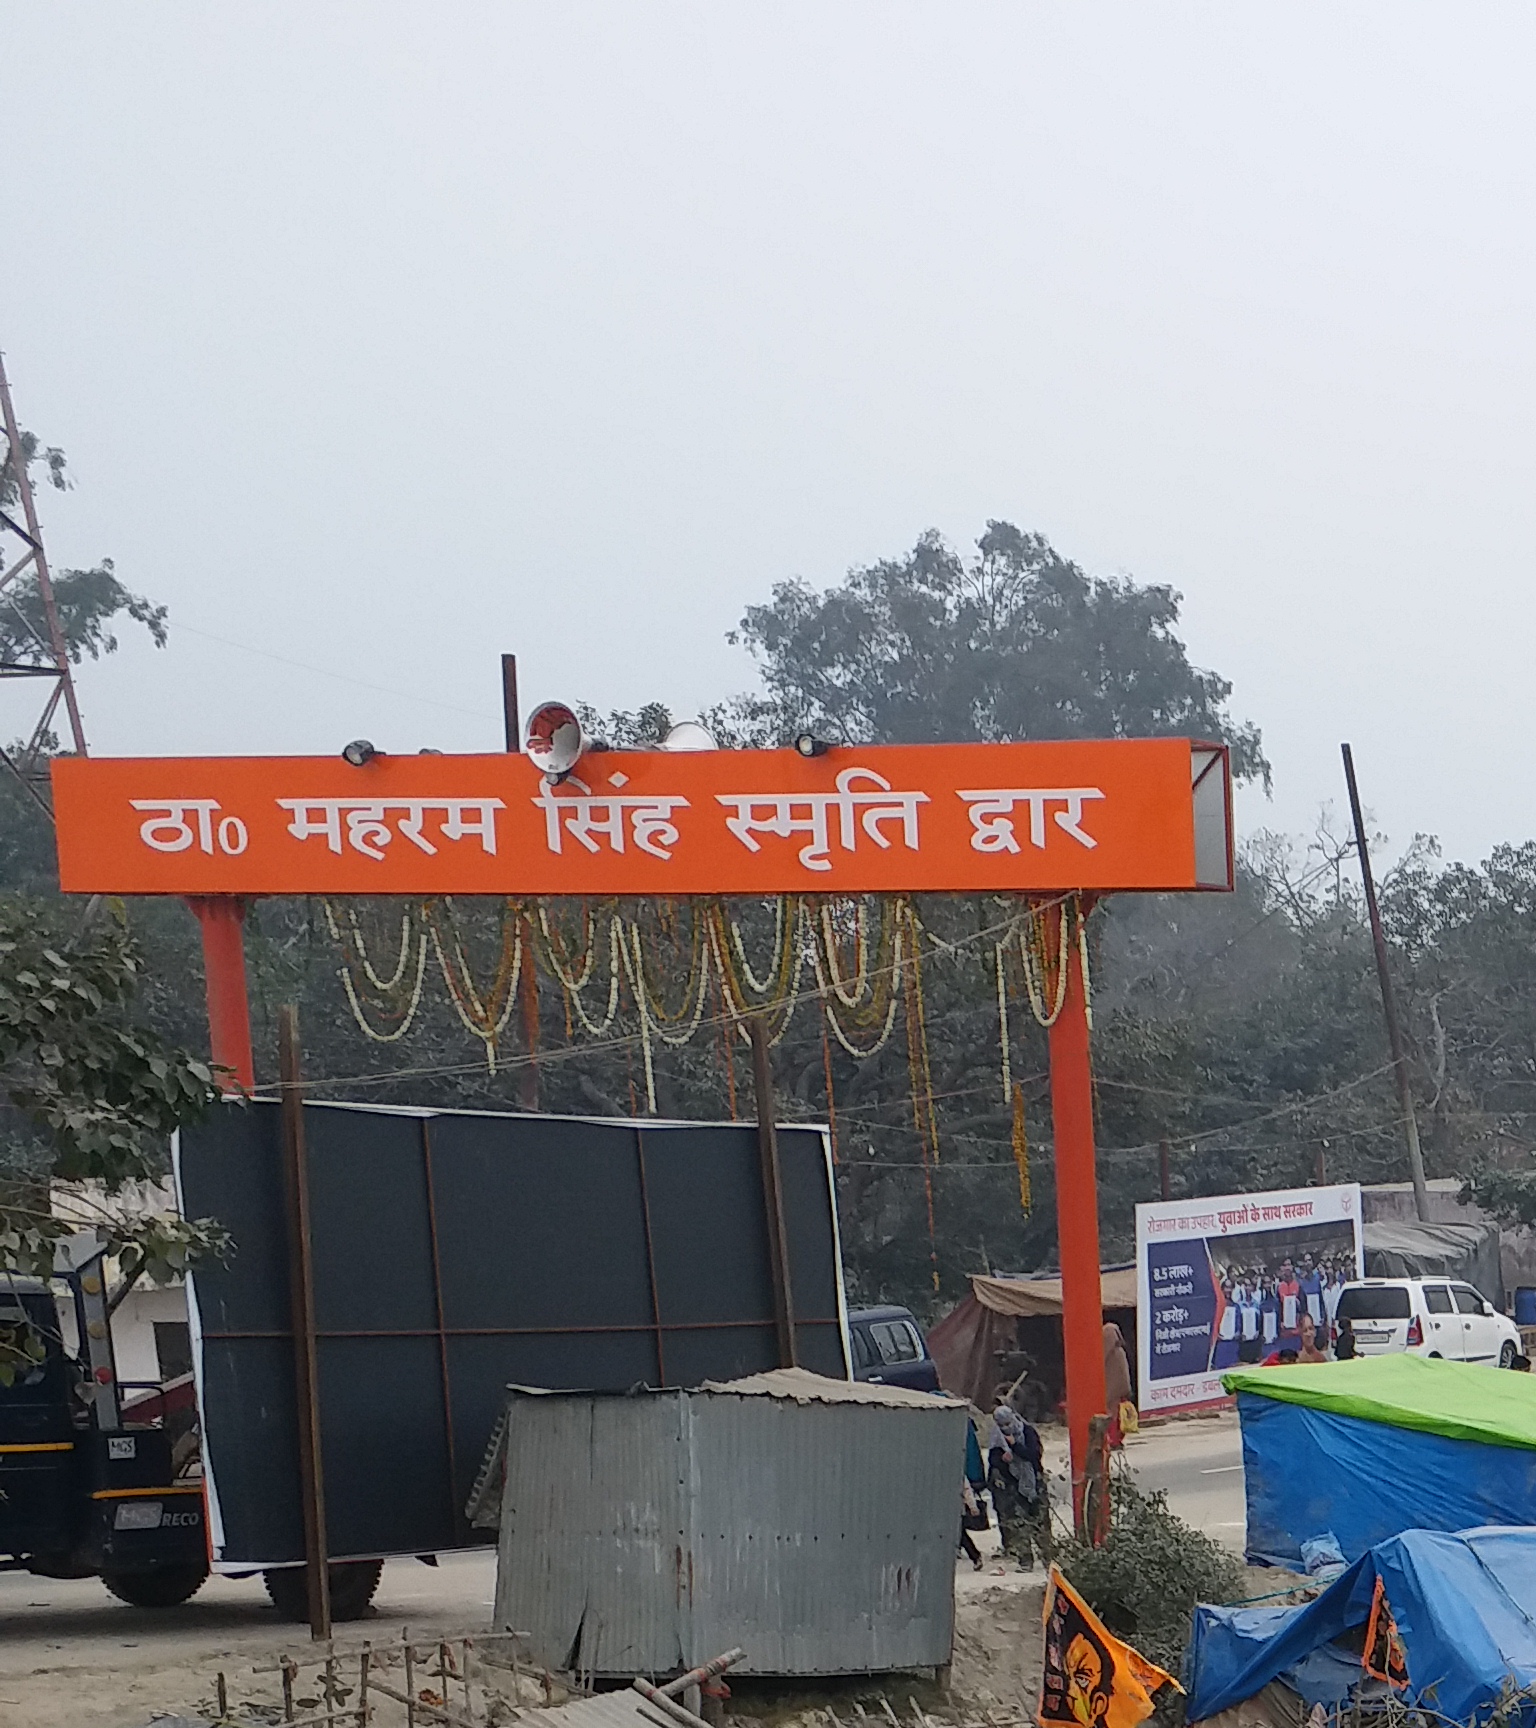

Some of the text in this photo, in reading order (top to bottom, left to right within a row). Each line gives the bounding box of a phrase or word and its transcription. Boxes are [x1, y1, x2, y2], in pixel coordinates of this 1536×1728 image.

[276, 796, 507, 861] महरम
[531, 773, 691, 862] सिंह
[715, 766, 931, 873] स्मृति
[955, 786, 1106, 855] द्वार
[1217, 1203, 1249, 1233] युवाओं
[1250, 1202, 1260, 1222] के
[1262, 1205, 1281, 1222] साथ
[1283, 1201, 1314, 1219] सरकार
